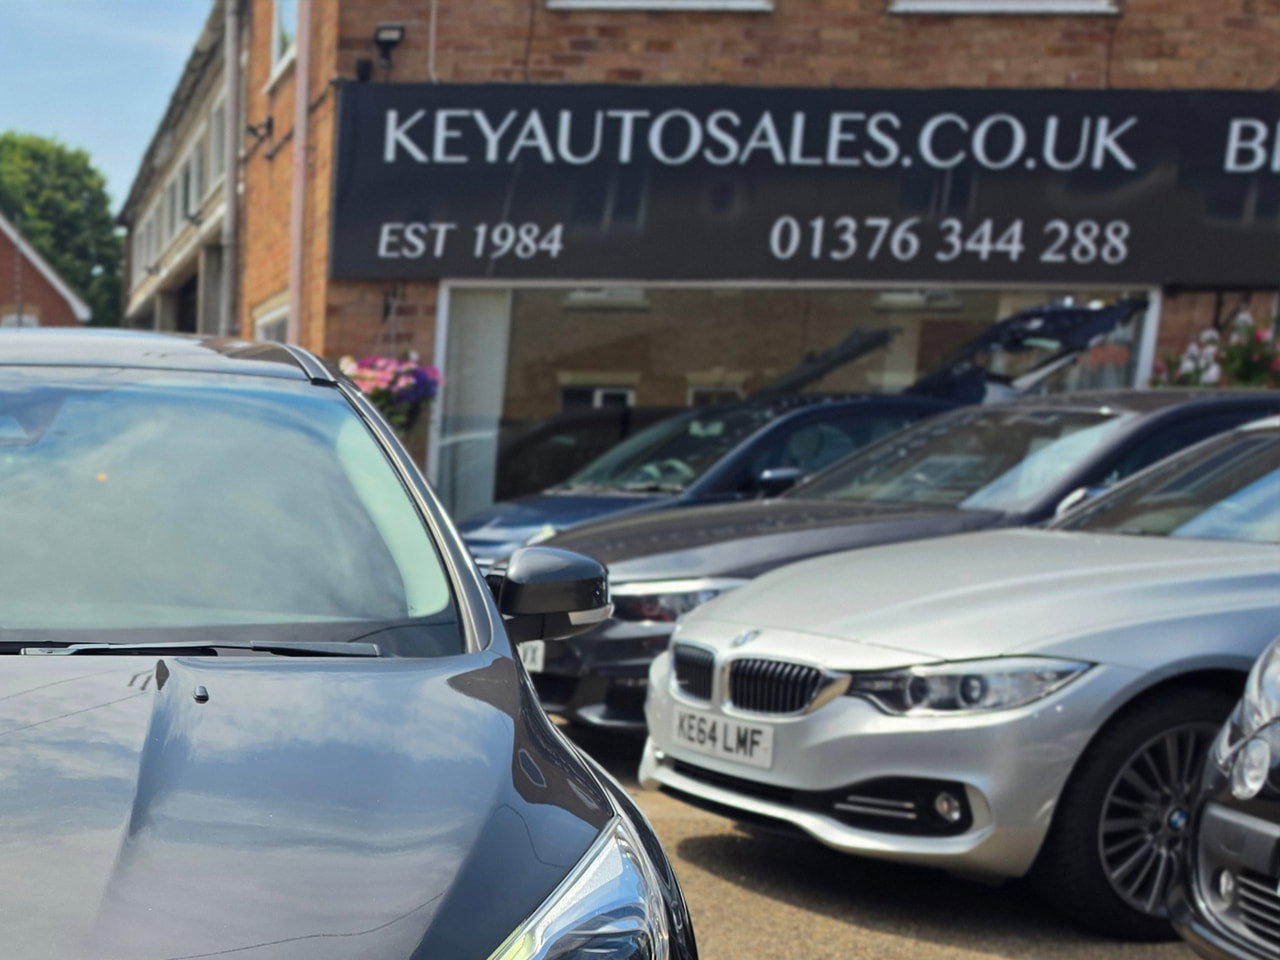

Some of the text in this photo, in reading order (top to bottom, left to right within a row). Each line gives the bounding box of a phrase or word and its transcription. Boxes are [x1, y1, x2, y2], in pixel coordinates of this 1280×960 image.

[383, 109, 1138, 170] KEYAUTOSALES.CO.UK
[377, 222, 564, 259] EST 1984
[769, 215, 1131, 265] 01376 344 288
[677, 710, 763, 758] KE64 LMF
